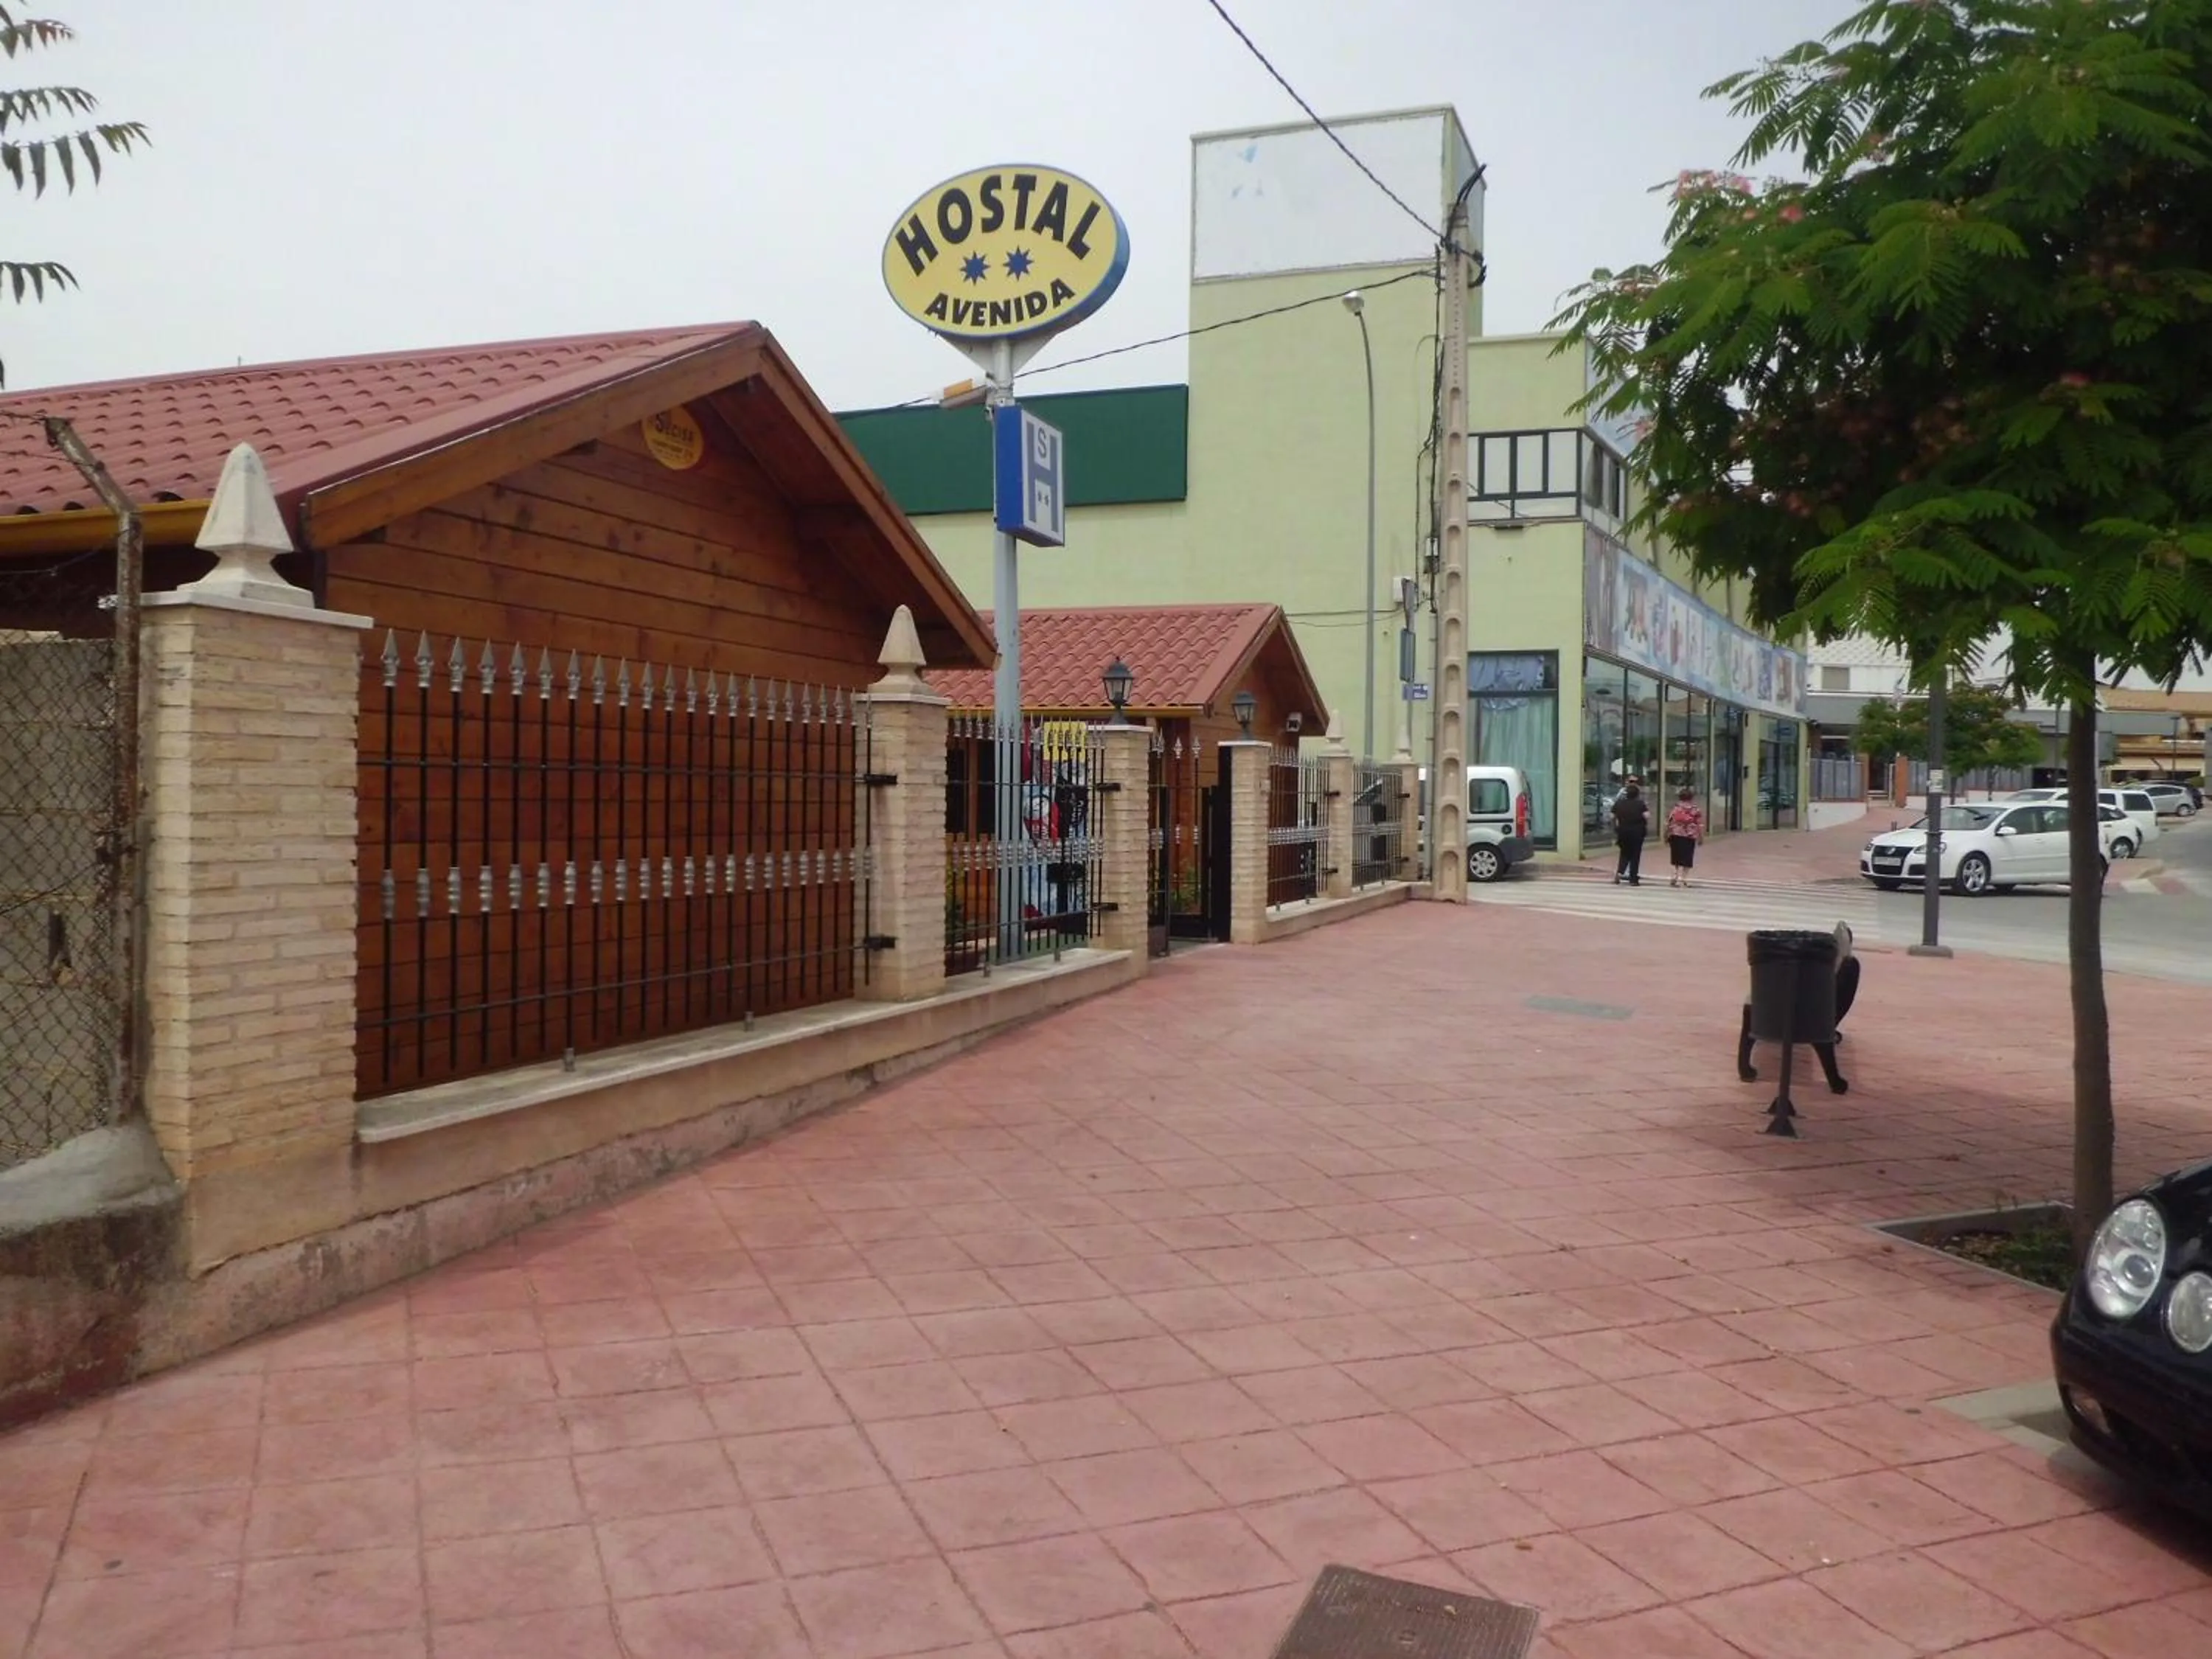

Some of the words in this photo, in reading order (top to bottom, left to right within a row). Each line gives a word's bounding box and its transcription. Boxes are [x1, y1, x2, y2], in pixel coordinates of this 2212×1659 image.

[895, 173, 1101, 276] HOSTAL
[925, 278, 1076, 327] AVENIDA
[1037, 427, 1047, 459] S
